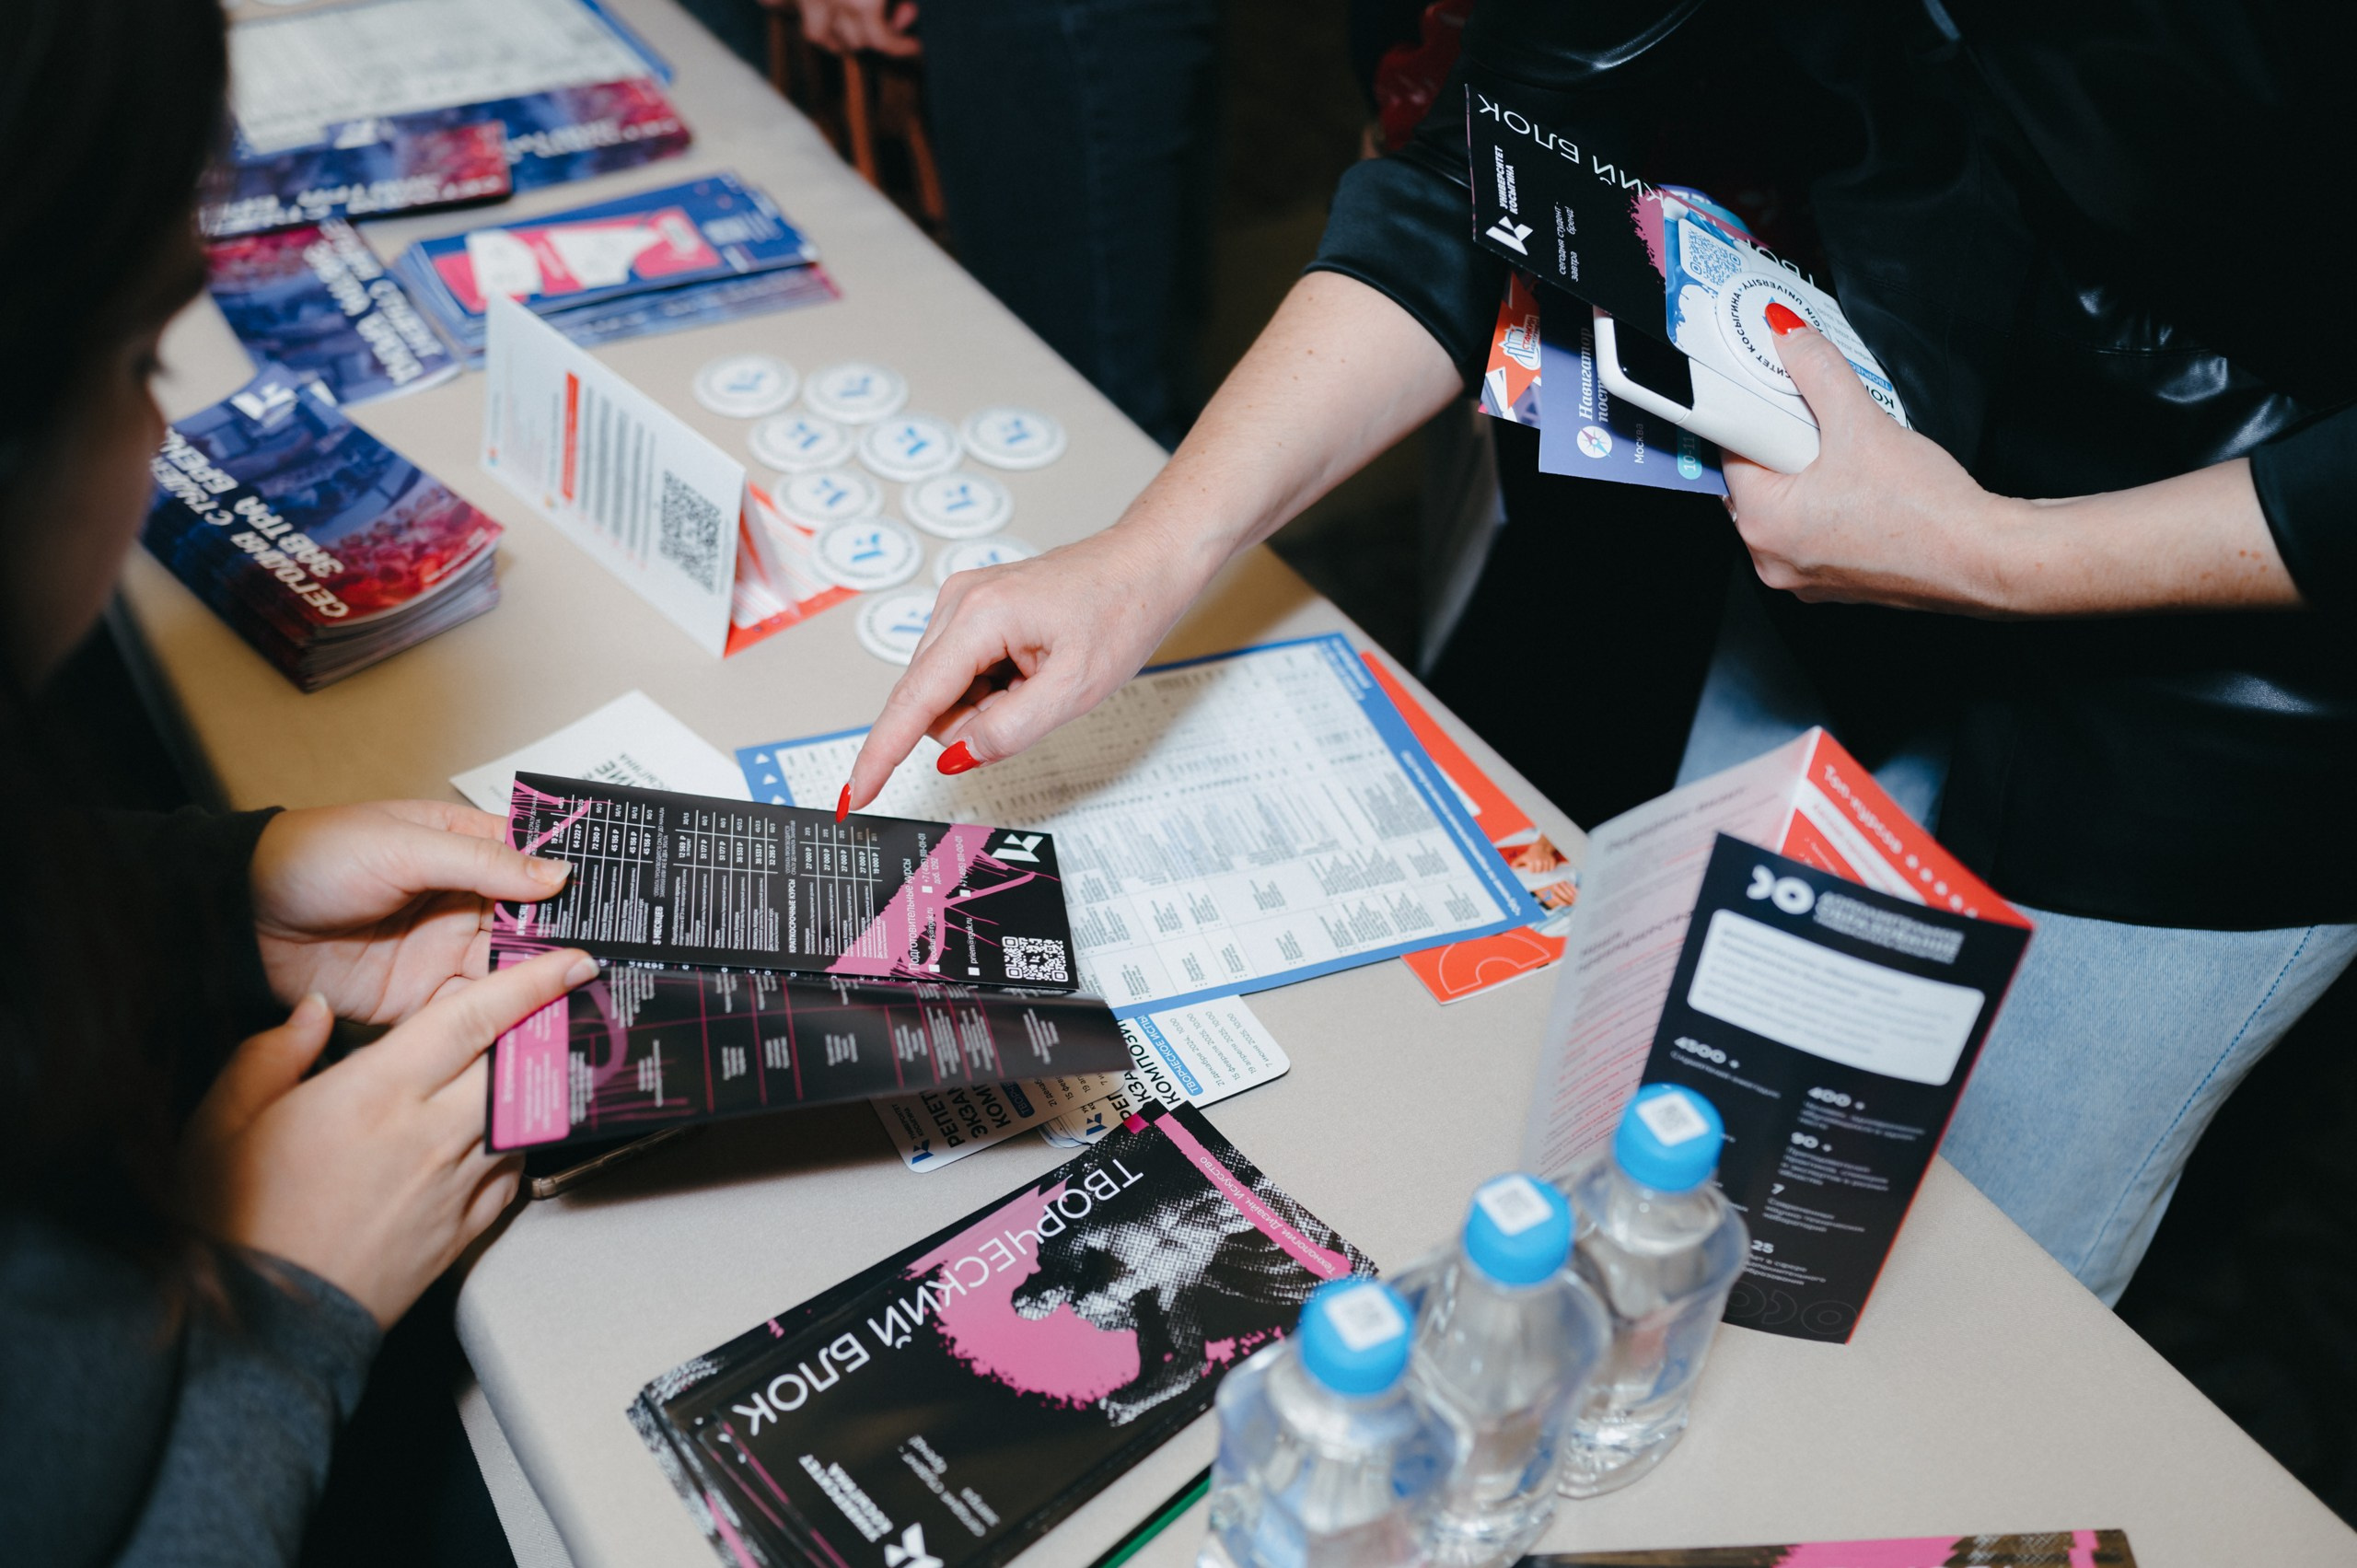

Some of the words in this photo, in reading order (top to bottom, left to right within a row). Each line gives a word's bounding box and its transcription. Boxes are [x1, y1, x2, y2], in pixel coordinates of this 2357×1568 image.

[1479, 94, 1581, 164] БЛОК
[1494, 145, 1507, 208] УНИВЕРСИТЕТ
[1505, 164, 1517, 214] КОСЫГИНА
[1554, 206, 1564, 238] студент
[1564, 206, 1575, 234] бренд!
[1742, 279, 1802, 305] UNIVERSITY
[1522, 316, 1534, 349] СТАНКИН
[1731, 292, 1755, 353] КОСЫГИНА
[1580, 327, 1593, 420] Навигатор
[1634, 423, 1643, 463] Москва
[141, 449, 237, 535] СТУДЕН
[231, 485, 345, 587] ЗАВТРА
[229, 518, 351, 626] СЕГОДНЯ
[592, 842, 598, 850] 72
[610, 843, 618, 852] 45
[629, 845, 636, 854] 45
[643, 846, 650, 854] 45
[903, 858, 913, 885] курсы
[923, 857, 931, 874] (495)
[923, 875, 930, 883] +7
[933, 870, 941, 884] доб.
[958, 862, 968, 878] (495)
[517, 903, 529, 929] МЕСЯЦ
[653, 905, 664, 938] МЕСЯЦЕВ
[788, 900, 796, 952] КРАТКОСРОЧНЫЕ
[907, 886, 920, 970] Подготовительные
[928, 907, 938, 960] podkurs@rguk.ru
[968, 917, 977, 964] priem@rguk.ru
[1168, 1016, 1186, 1035] 10:00
[1185, 1011, 1202, 1030] 10:00
[1204, 1008, 1221, 1028] 10:00
[1225, 1010, 1243, 1030] 10:00
[1155, 1037, 1199, 1095] ТВОРЧЕСКОЕ
[1194, 1049, 1221, 1081] декабря
[1210, 1042, 1237, 1075] февраля
[1229, 1040, 1253, 1069] апреля
[1251, 1042, 1270, 1064] июня
[1214, 1077, 1225, 1087] 21
[1231, 1071, 1241, 1081] 15
[1247, 1064, 1257, 1074] 19
[1064, 1090, 1074, 1100] 15
[1081, 1083, 1091, 1093] 19
[1048, 1098, 1057, 1108] 21
[923, 1092, 965, 1149] РЕПЕТ
[1195, 1154, 1248, 1201] Искусство
[1770, 1182, 1785, 1196] 7
[1241, 1194, 1283, 1233] Дизайн.
[875, 1156, 1144, 1349] ТВОРЧЕСКИЙ
[1278, 1224, 1337, 1276] Технологии.
[1751, 1239, 1774, 1254] 25
[731, 1331, 868, 1436] БЛОК
